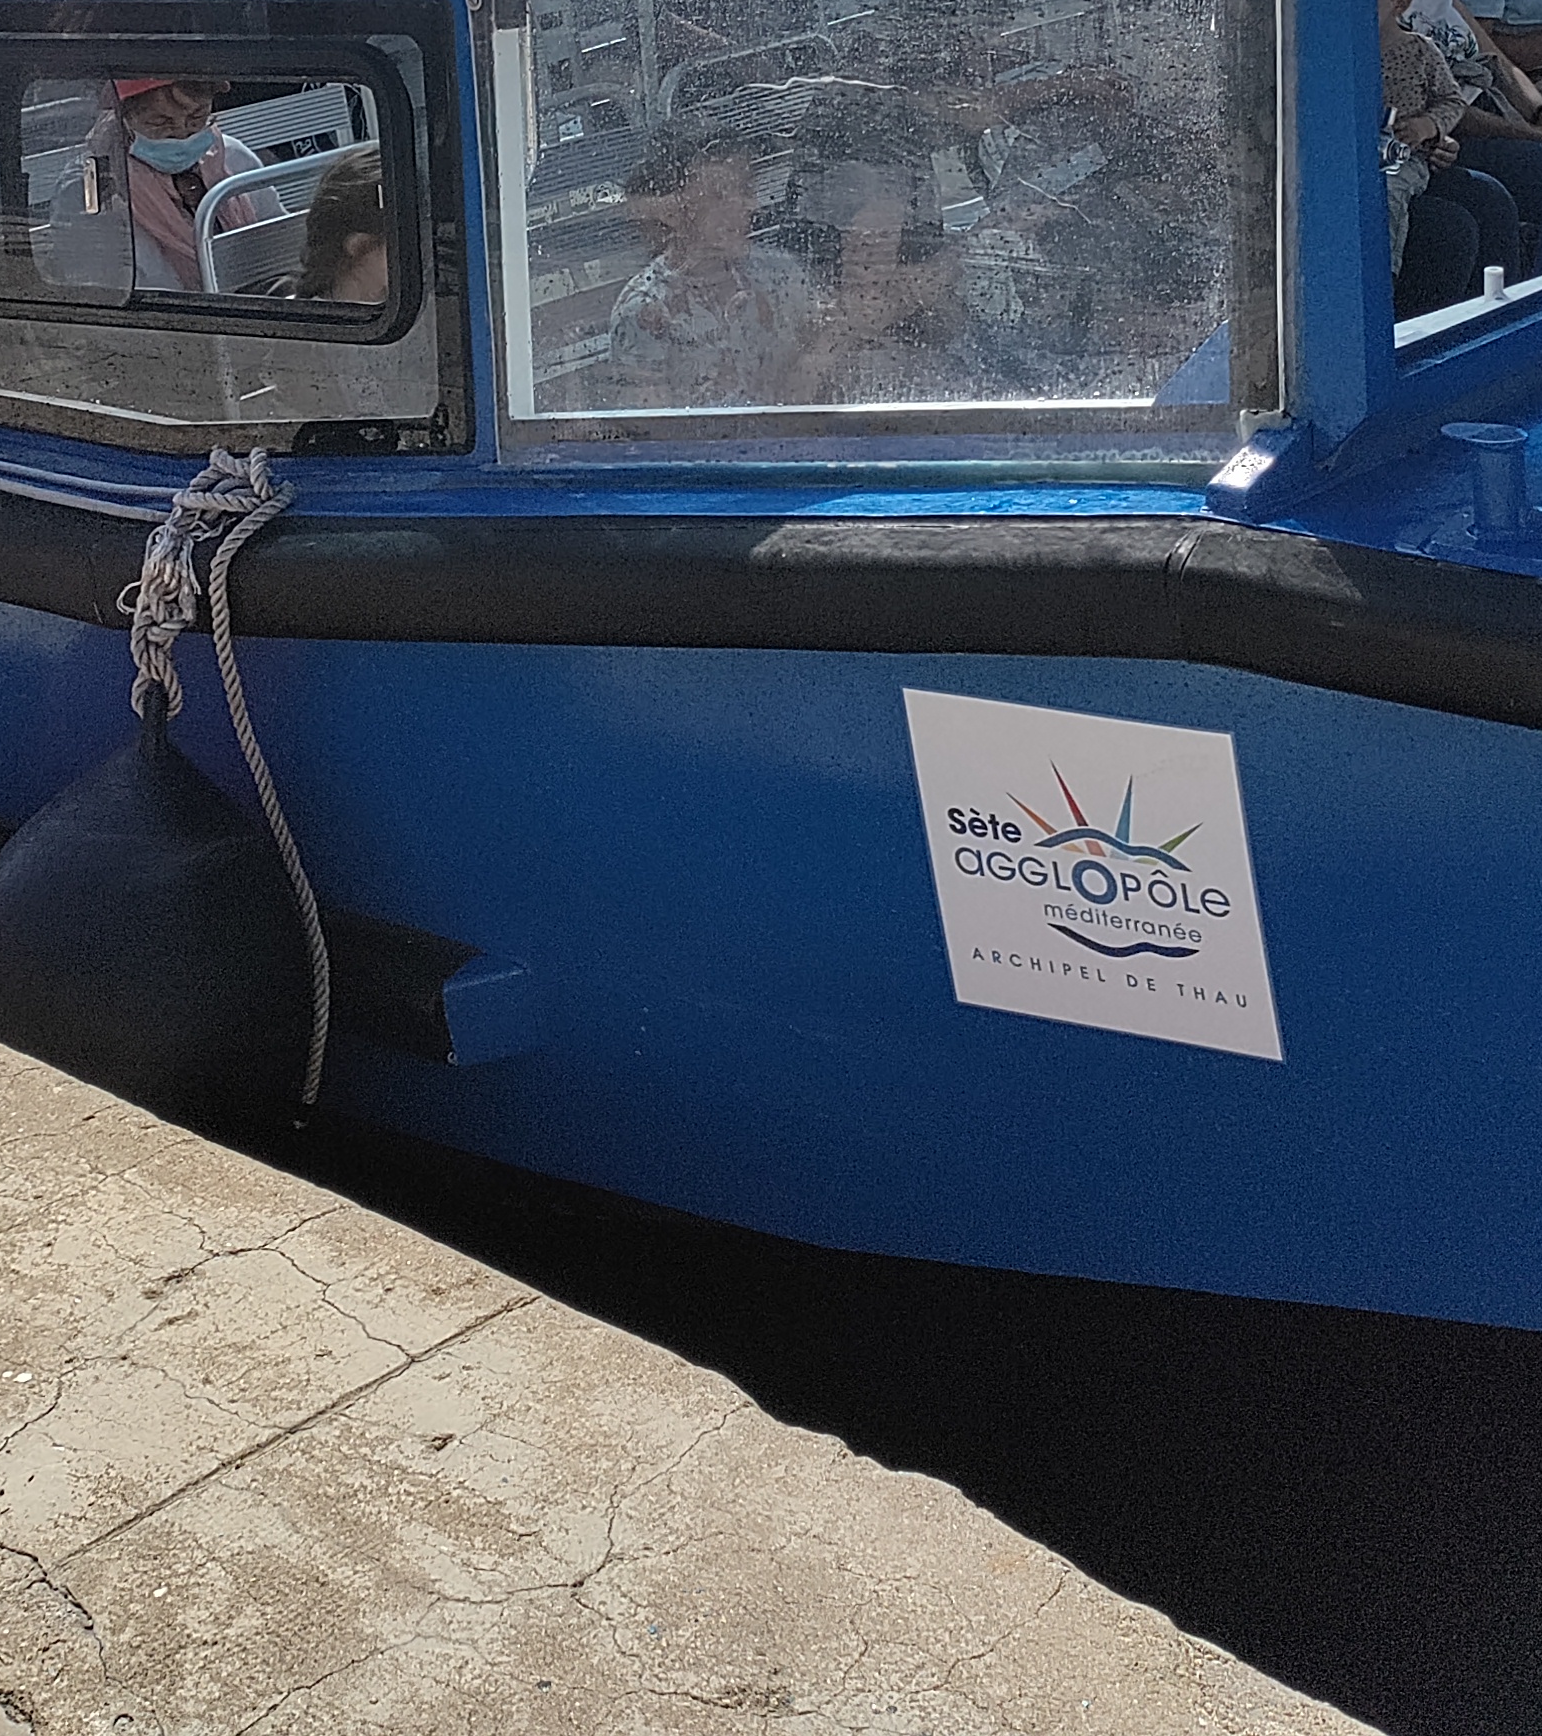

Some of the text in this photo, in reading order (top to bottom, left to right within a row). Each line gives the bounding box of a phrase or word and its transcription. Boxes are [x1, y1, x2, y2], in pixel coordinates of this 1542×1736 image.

[947, 807, 1022, 843] Sète
[1044, 903, 1202, 943] méditerranée
[972, 947, 1248, 1008] ARCHIPEL DE THAU
